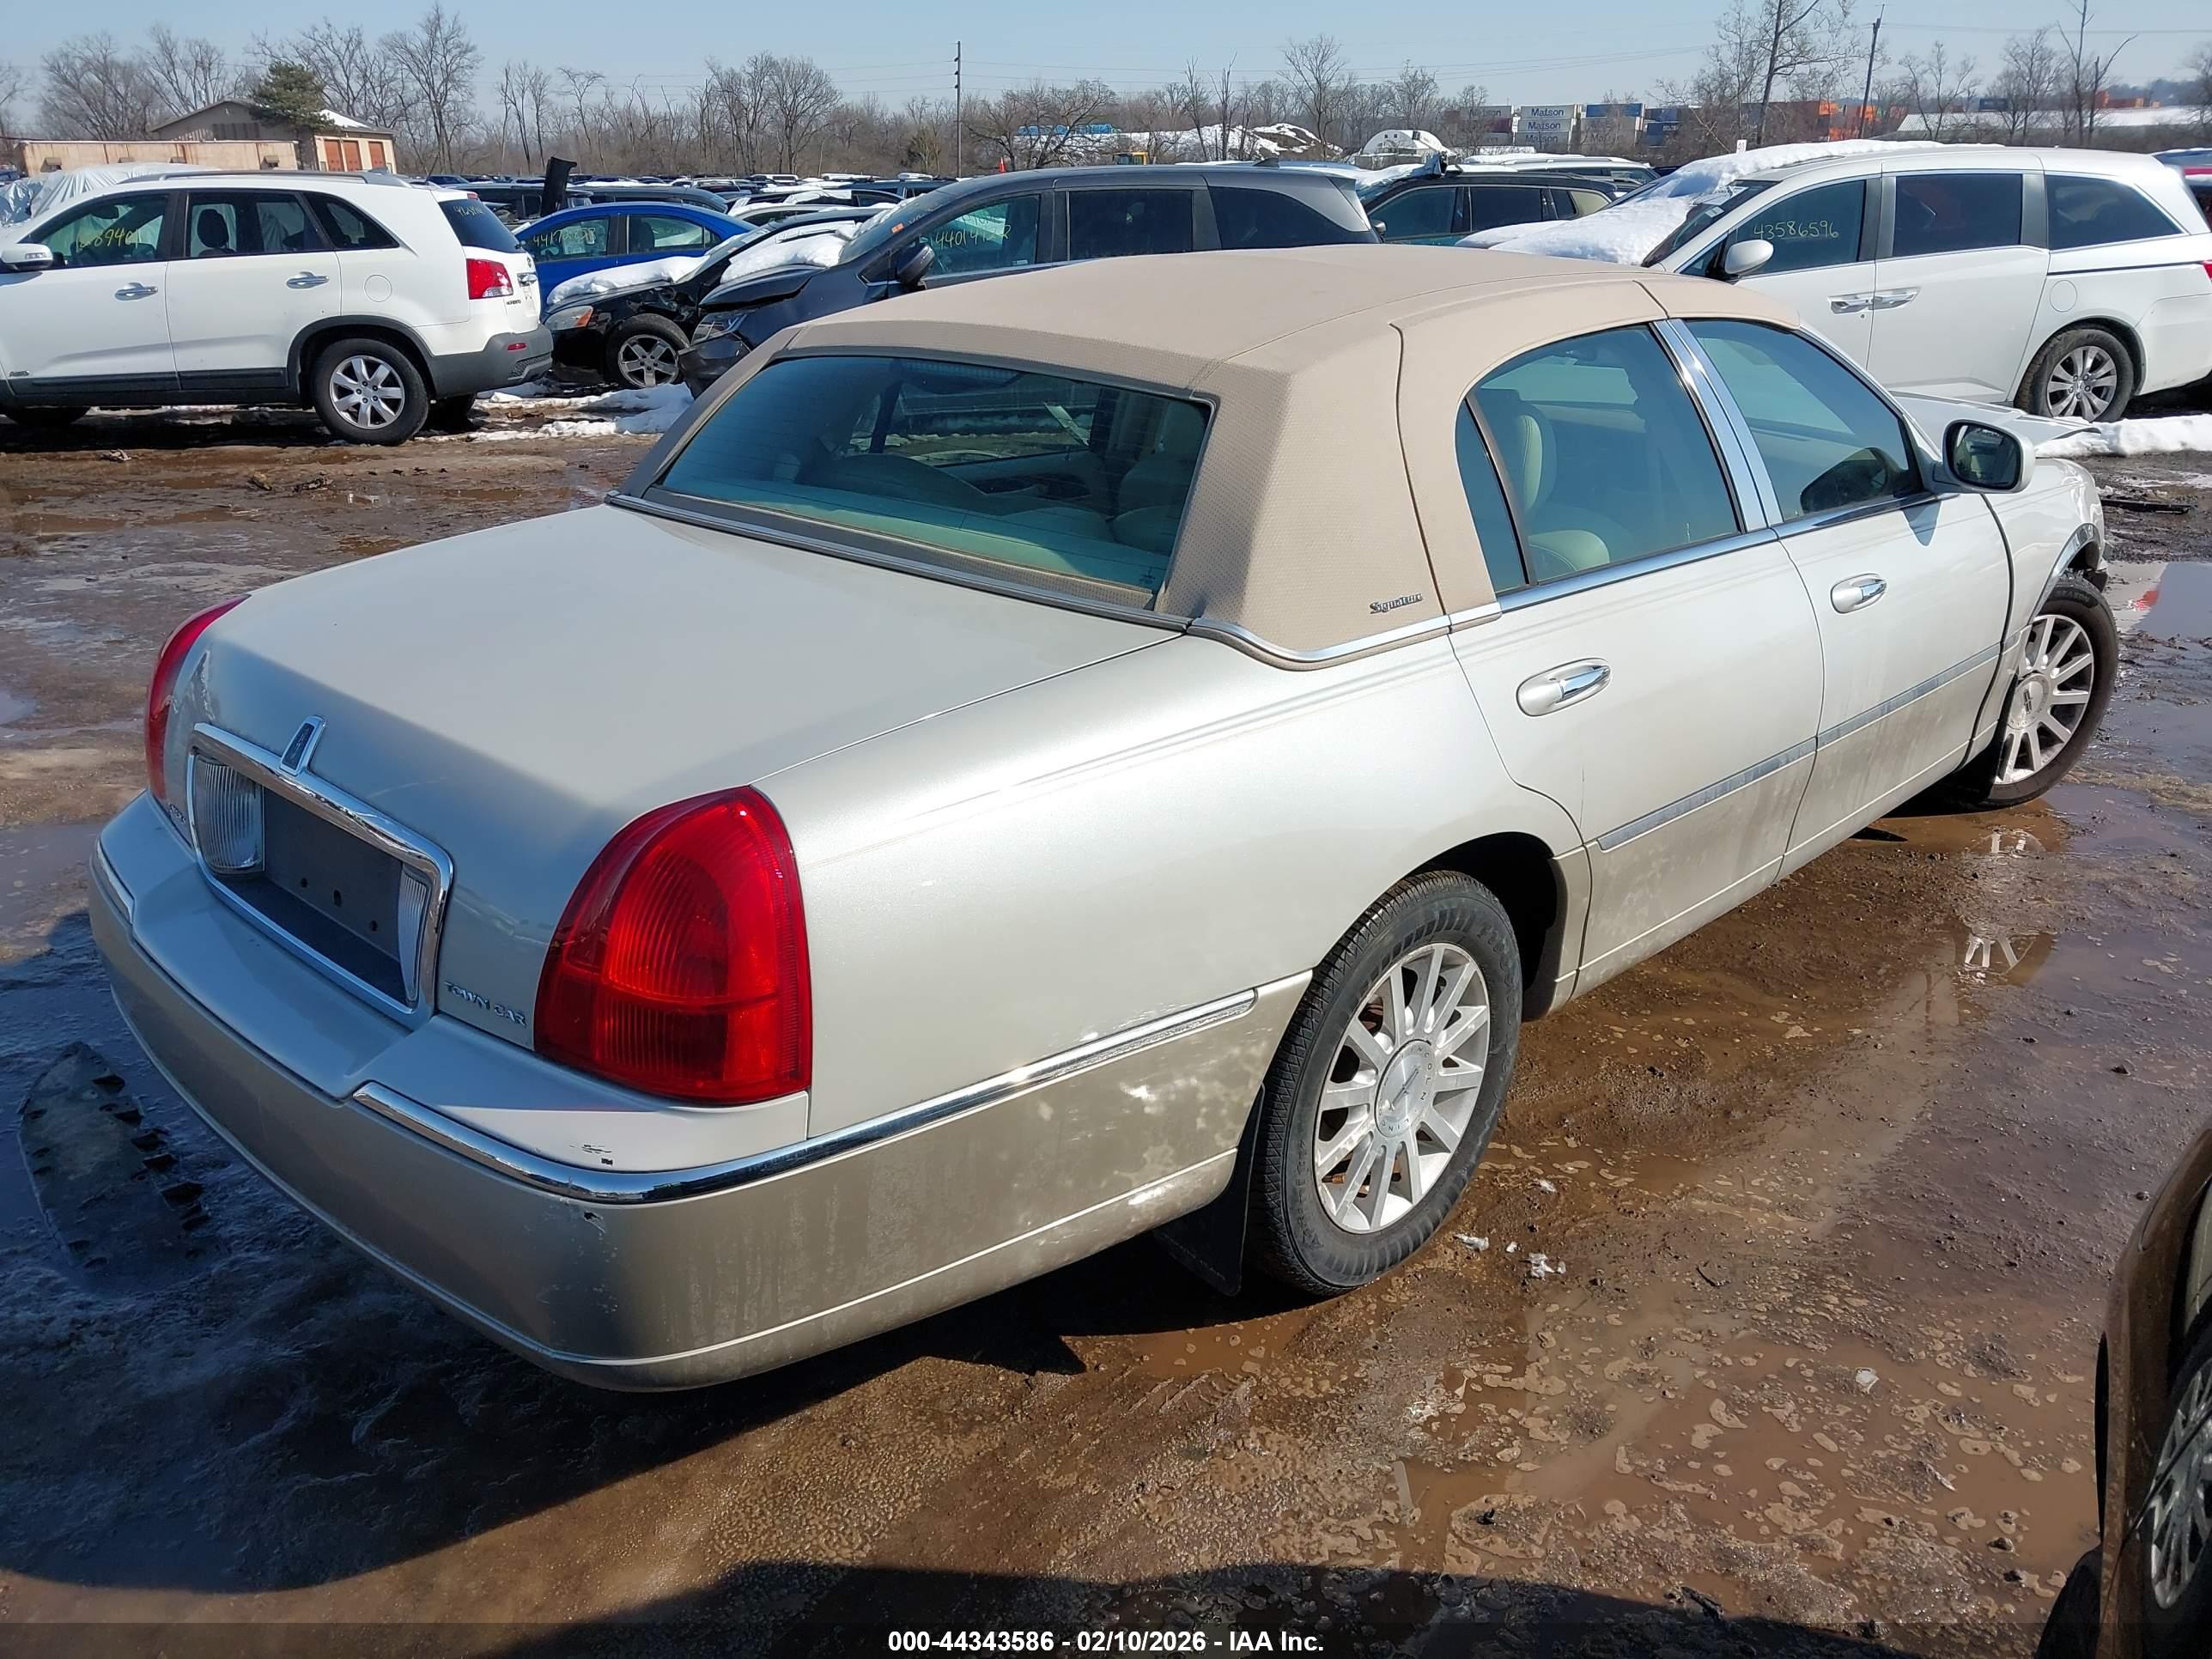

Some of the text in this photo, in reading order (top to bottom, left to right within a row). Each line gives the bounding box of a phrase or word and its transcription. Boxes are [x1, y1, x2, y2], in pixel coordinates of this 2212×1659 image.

[1531, 107, 1564, 117] Matson
[1528, 121, 1561, 131] Matson
[1525, 134, 1559, 143] Matson
[1753, 220, 1839, 240] 43586596
[1370, 593, 1424, 614] Signature
[444, 981, 527, 1028] TOWN CAR
